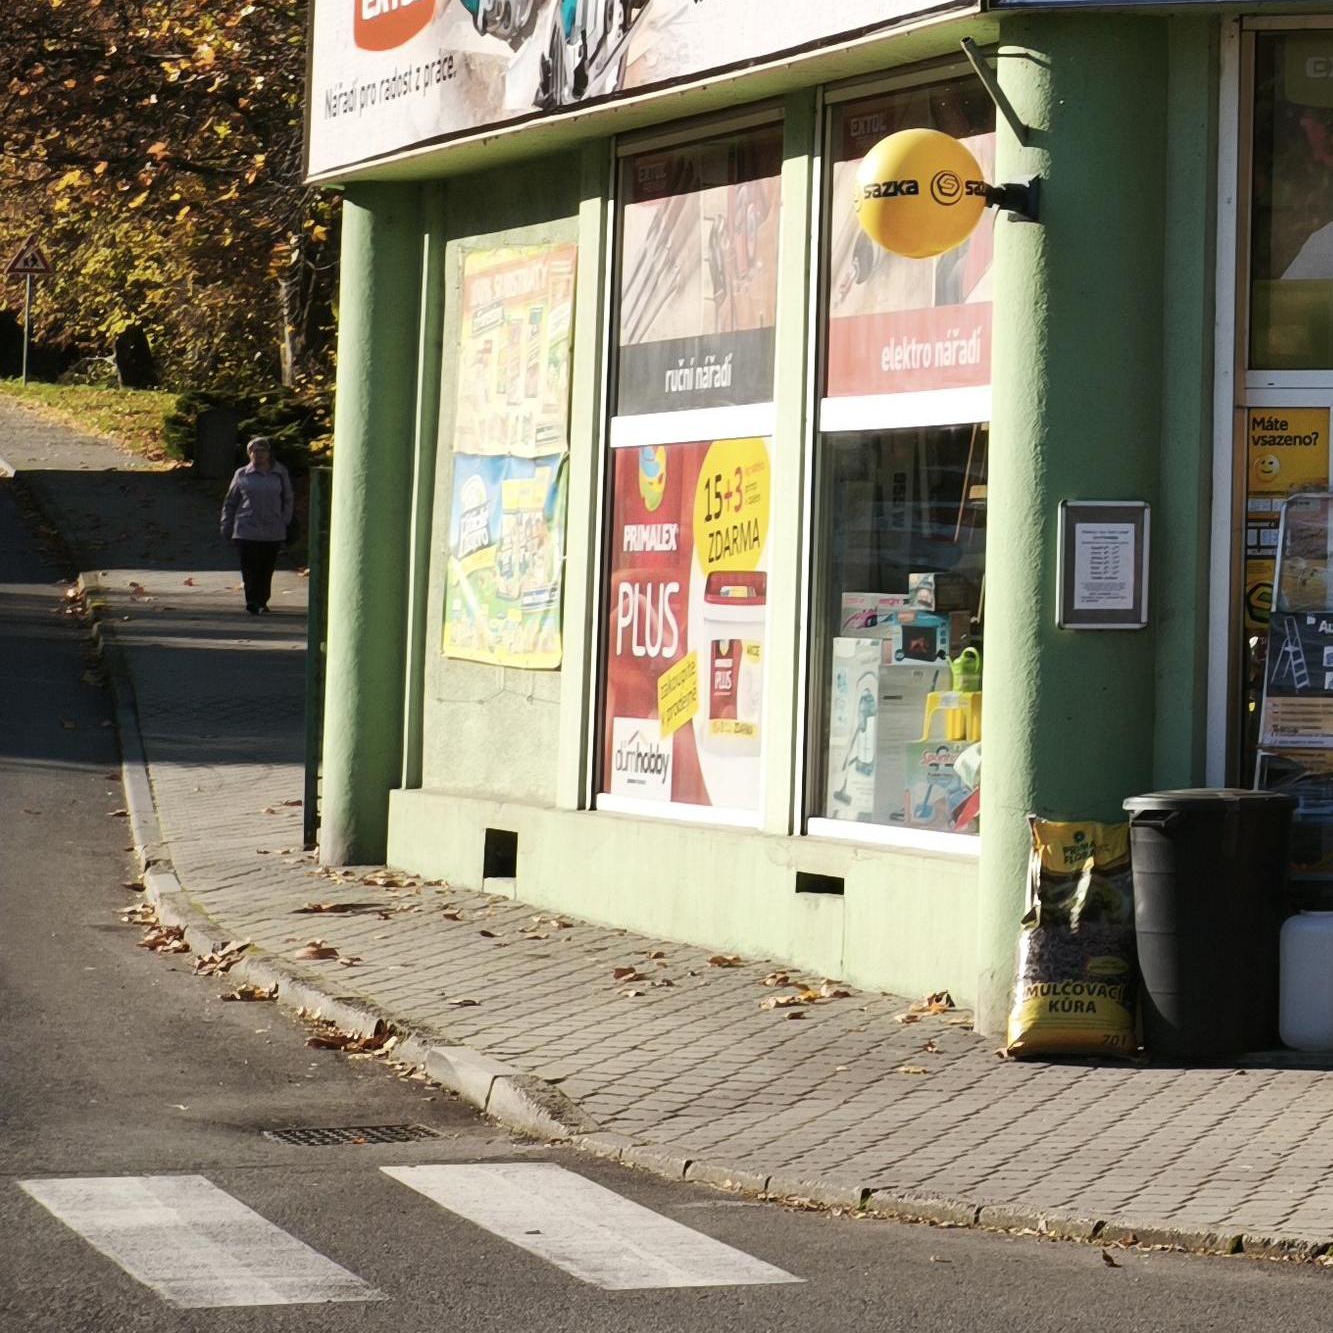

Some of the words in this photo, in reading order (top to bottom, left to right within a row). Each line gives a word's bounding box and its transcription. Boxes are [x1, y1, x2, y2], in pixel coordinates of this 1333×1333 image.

[360, 83, 376, 118] pro
[379, 64, 412, 103] radost
[665, 357, 695, 392] ruční
[696, 352, 733, 390] nářadí
[881, 338, 931, 372] elektro
[935, 325, 982, 369] nářadí
[1252, 416, 1288, 432] Máte
[1252, 431, 1319, 447] vsazeno?
[708, 517, 760, 564] ZDARMA
[616, 581, 680, 660] PLUS
